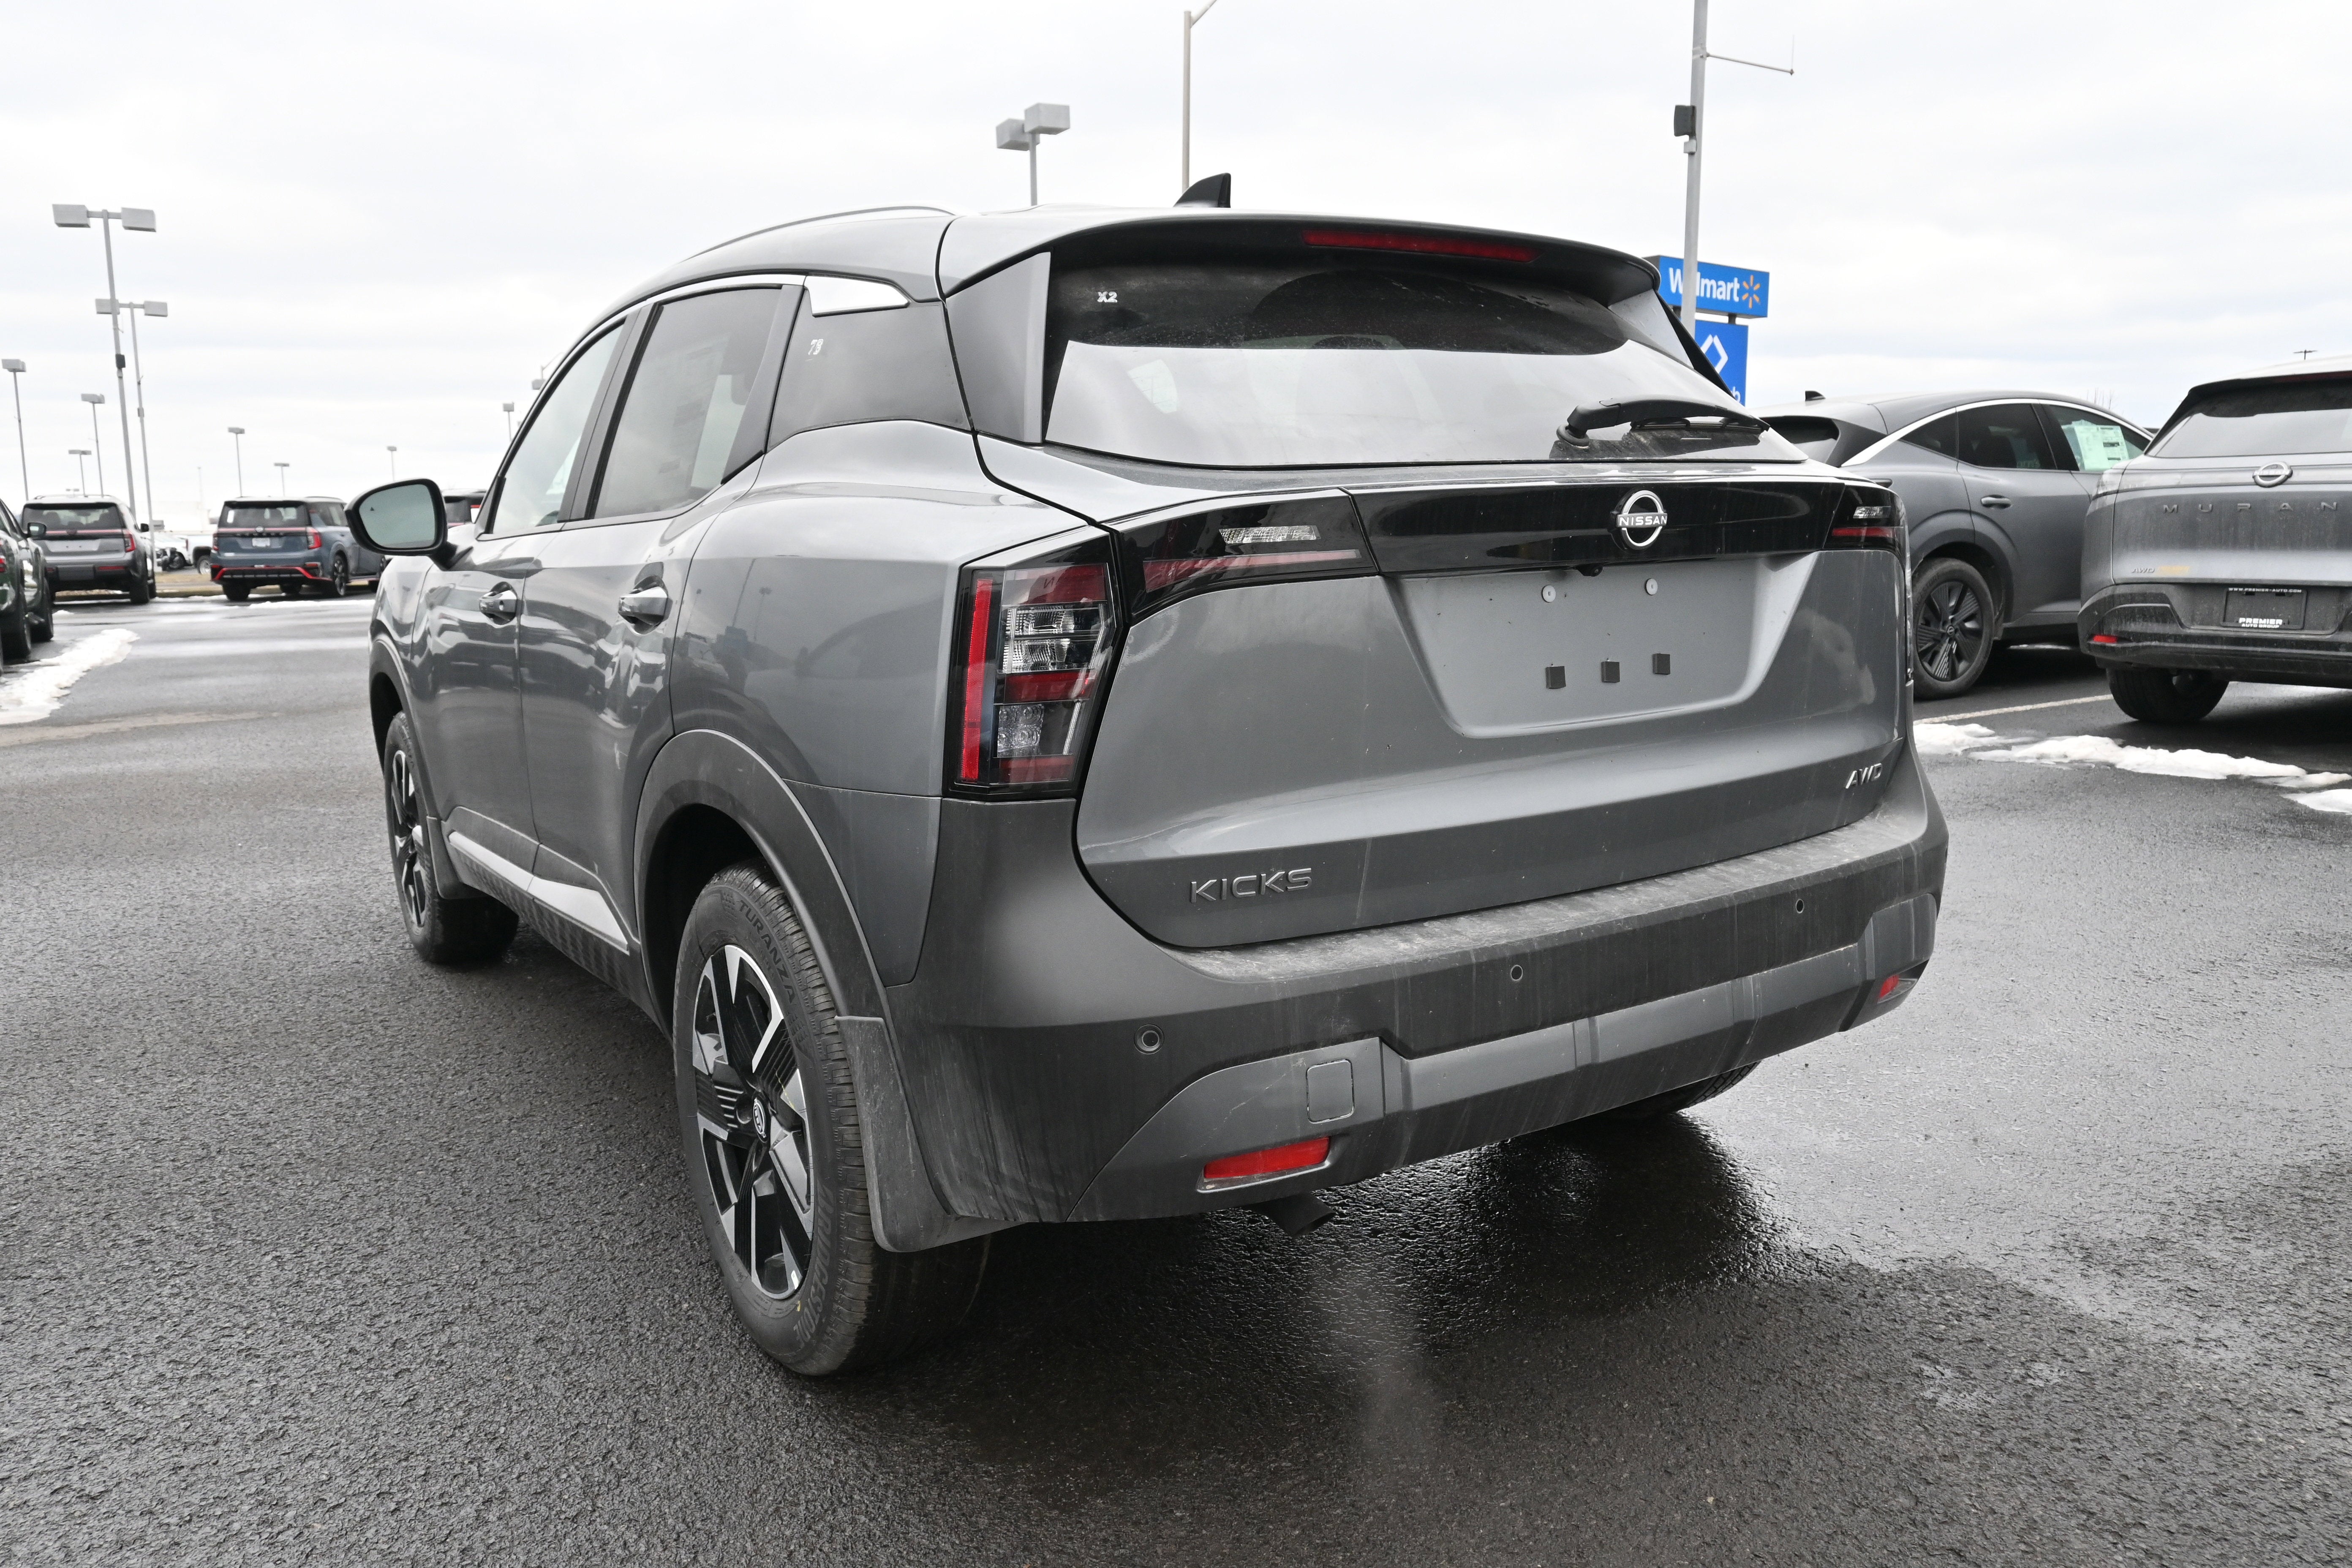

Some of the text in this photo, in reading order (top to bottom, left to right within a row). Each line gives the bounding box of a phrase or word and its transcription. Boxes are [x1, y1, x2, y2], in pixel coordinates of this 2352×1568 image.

[1097, 291, 1118, 303] X2
[1669, 267, 1740, 302] Wlmart
[1619, 515, 1667, 526] NISSAN
[1845, 762, 1883, 789] AWD
[1190, 867, 1312, 903] KICKS
[739, 899, 795, 1004] TURANZA
